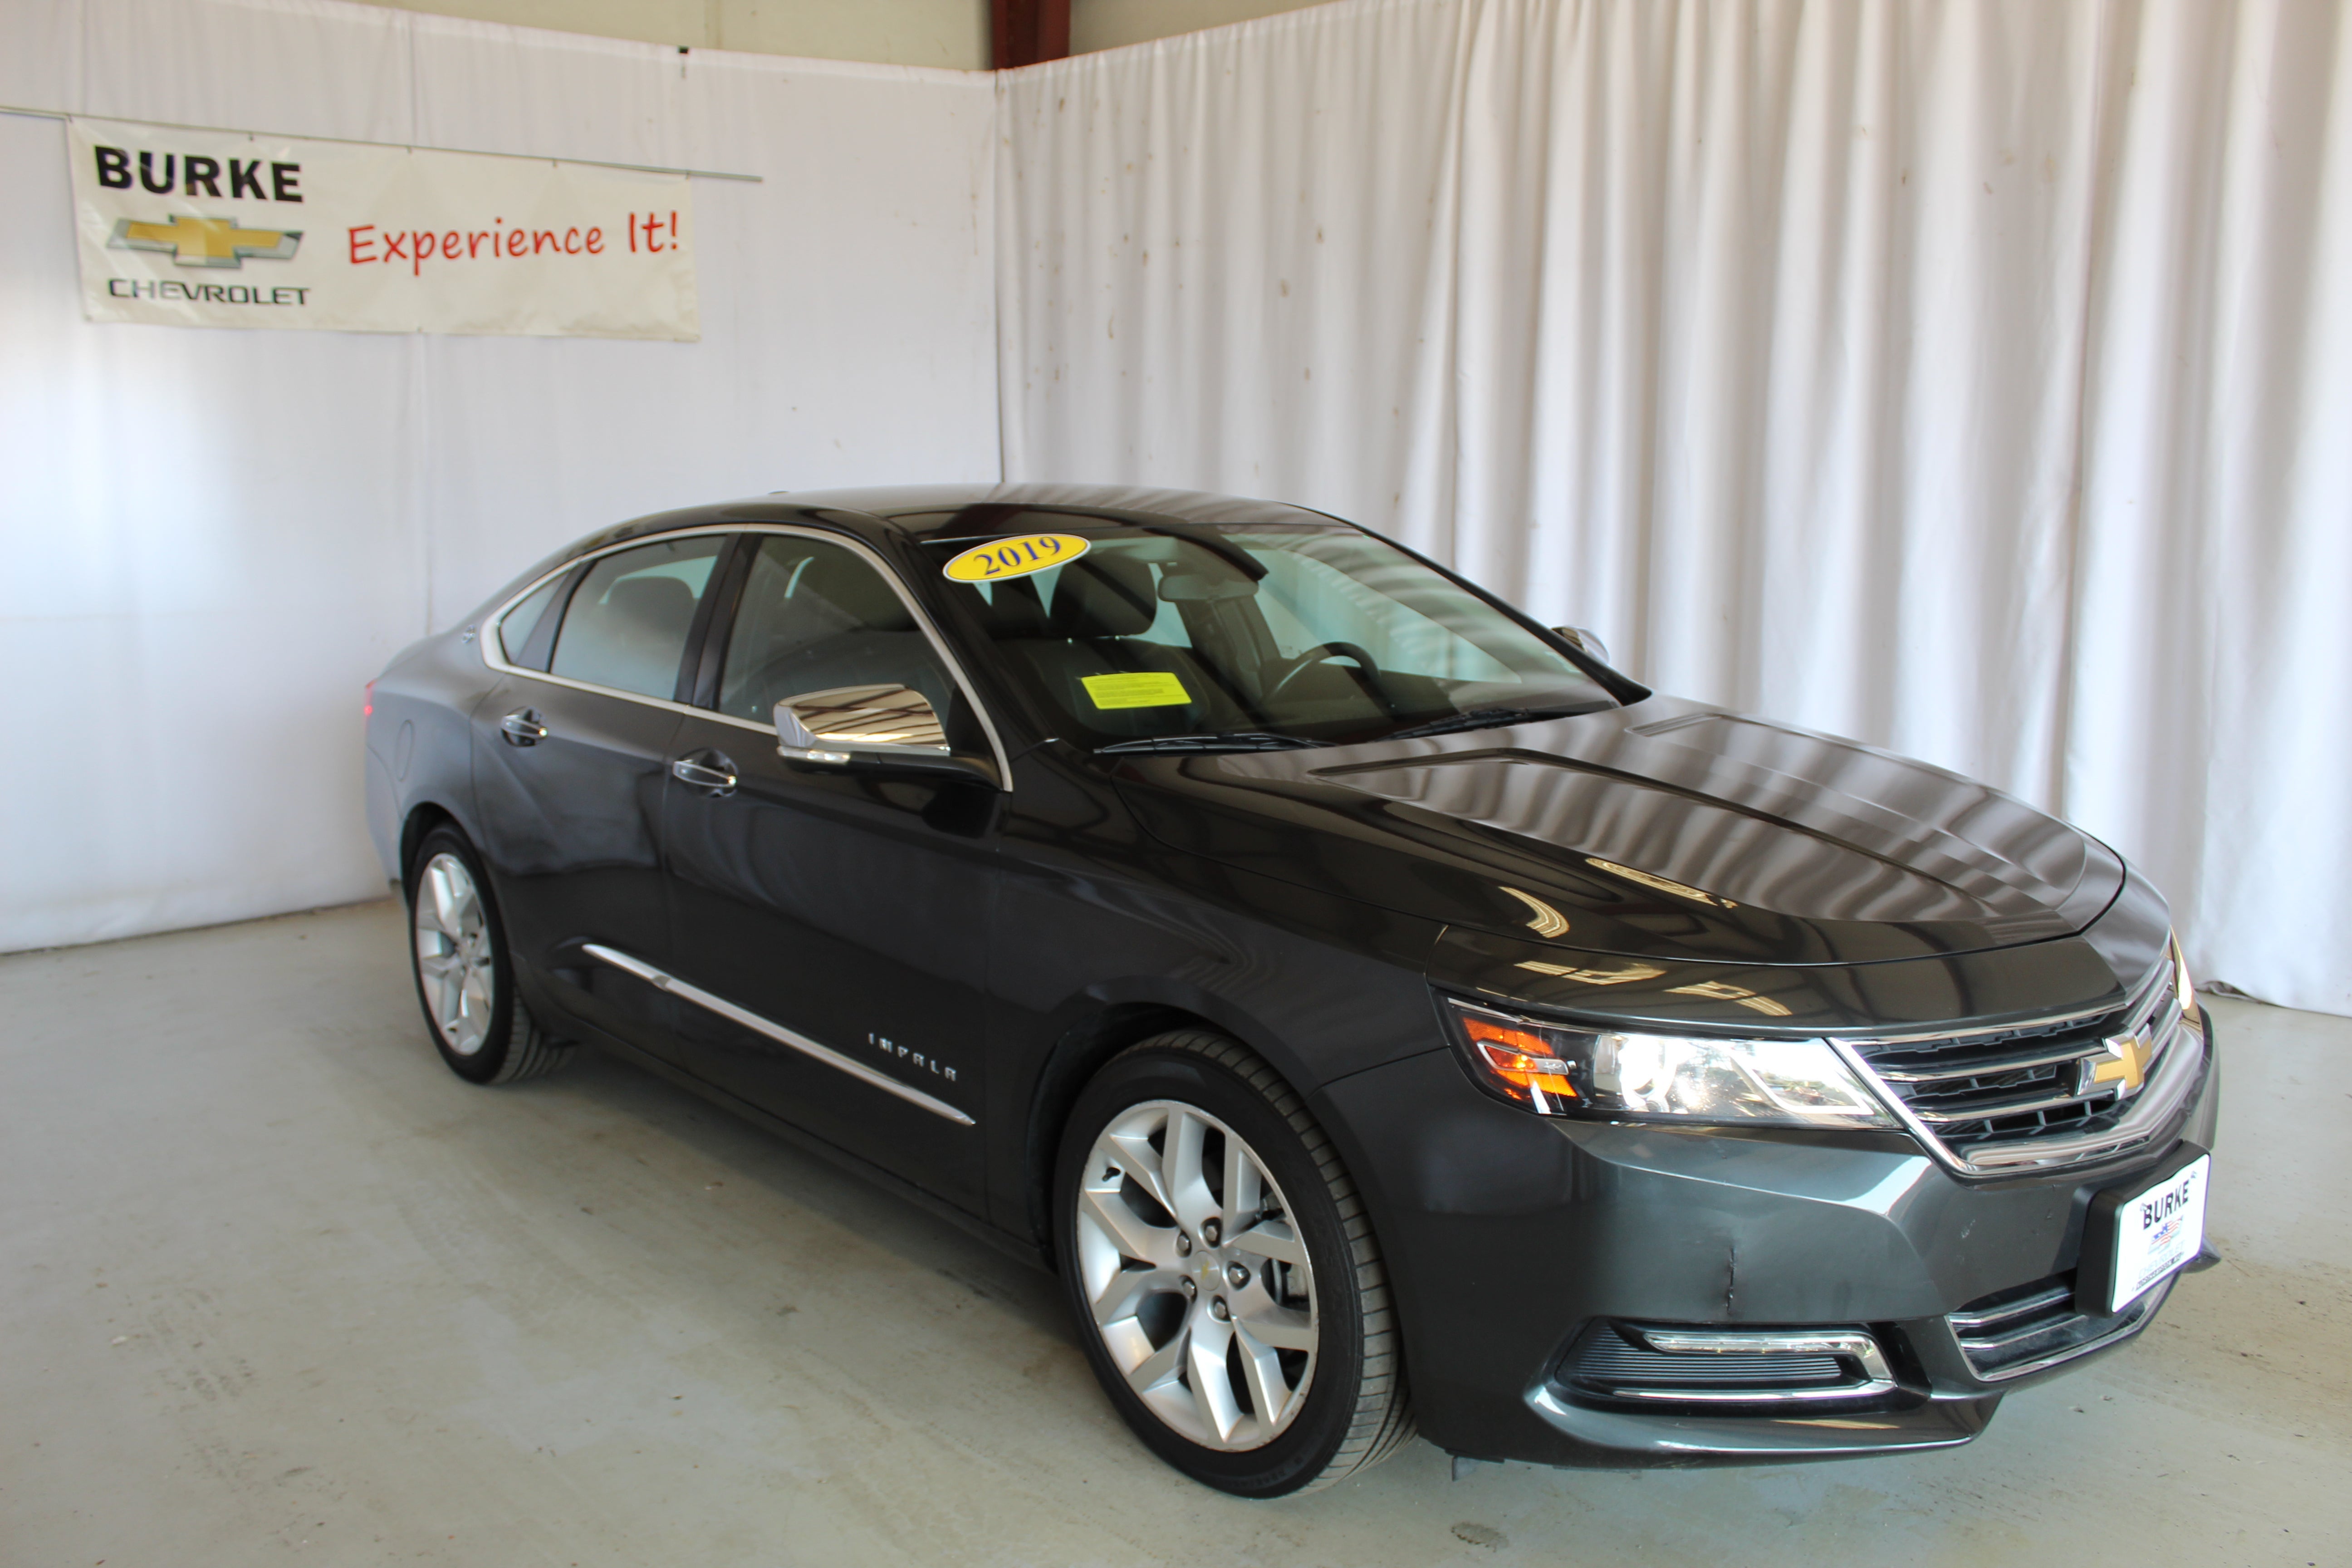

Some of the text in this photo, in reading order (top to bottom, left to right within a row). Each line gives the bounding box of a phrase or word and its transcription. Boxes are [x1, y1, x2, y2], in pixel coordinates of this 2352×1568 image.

[94, 145, 304, 203] BURKE
[348, 211, 678, 276] Experience It!
[108, 279, 309, 305] CHEVROLET
[973, 536, 1061, 575] 2019
[868, 1032, 956, 1082] IMPALA
[2143, 1180, 2190, 1230] BURKE
